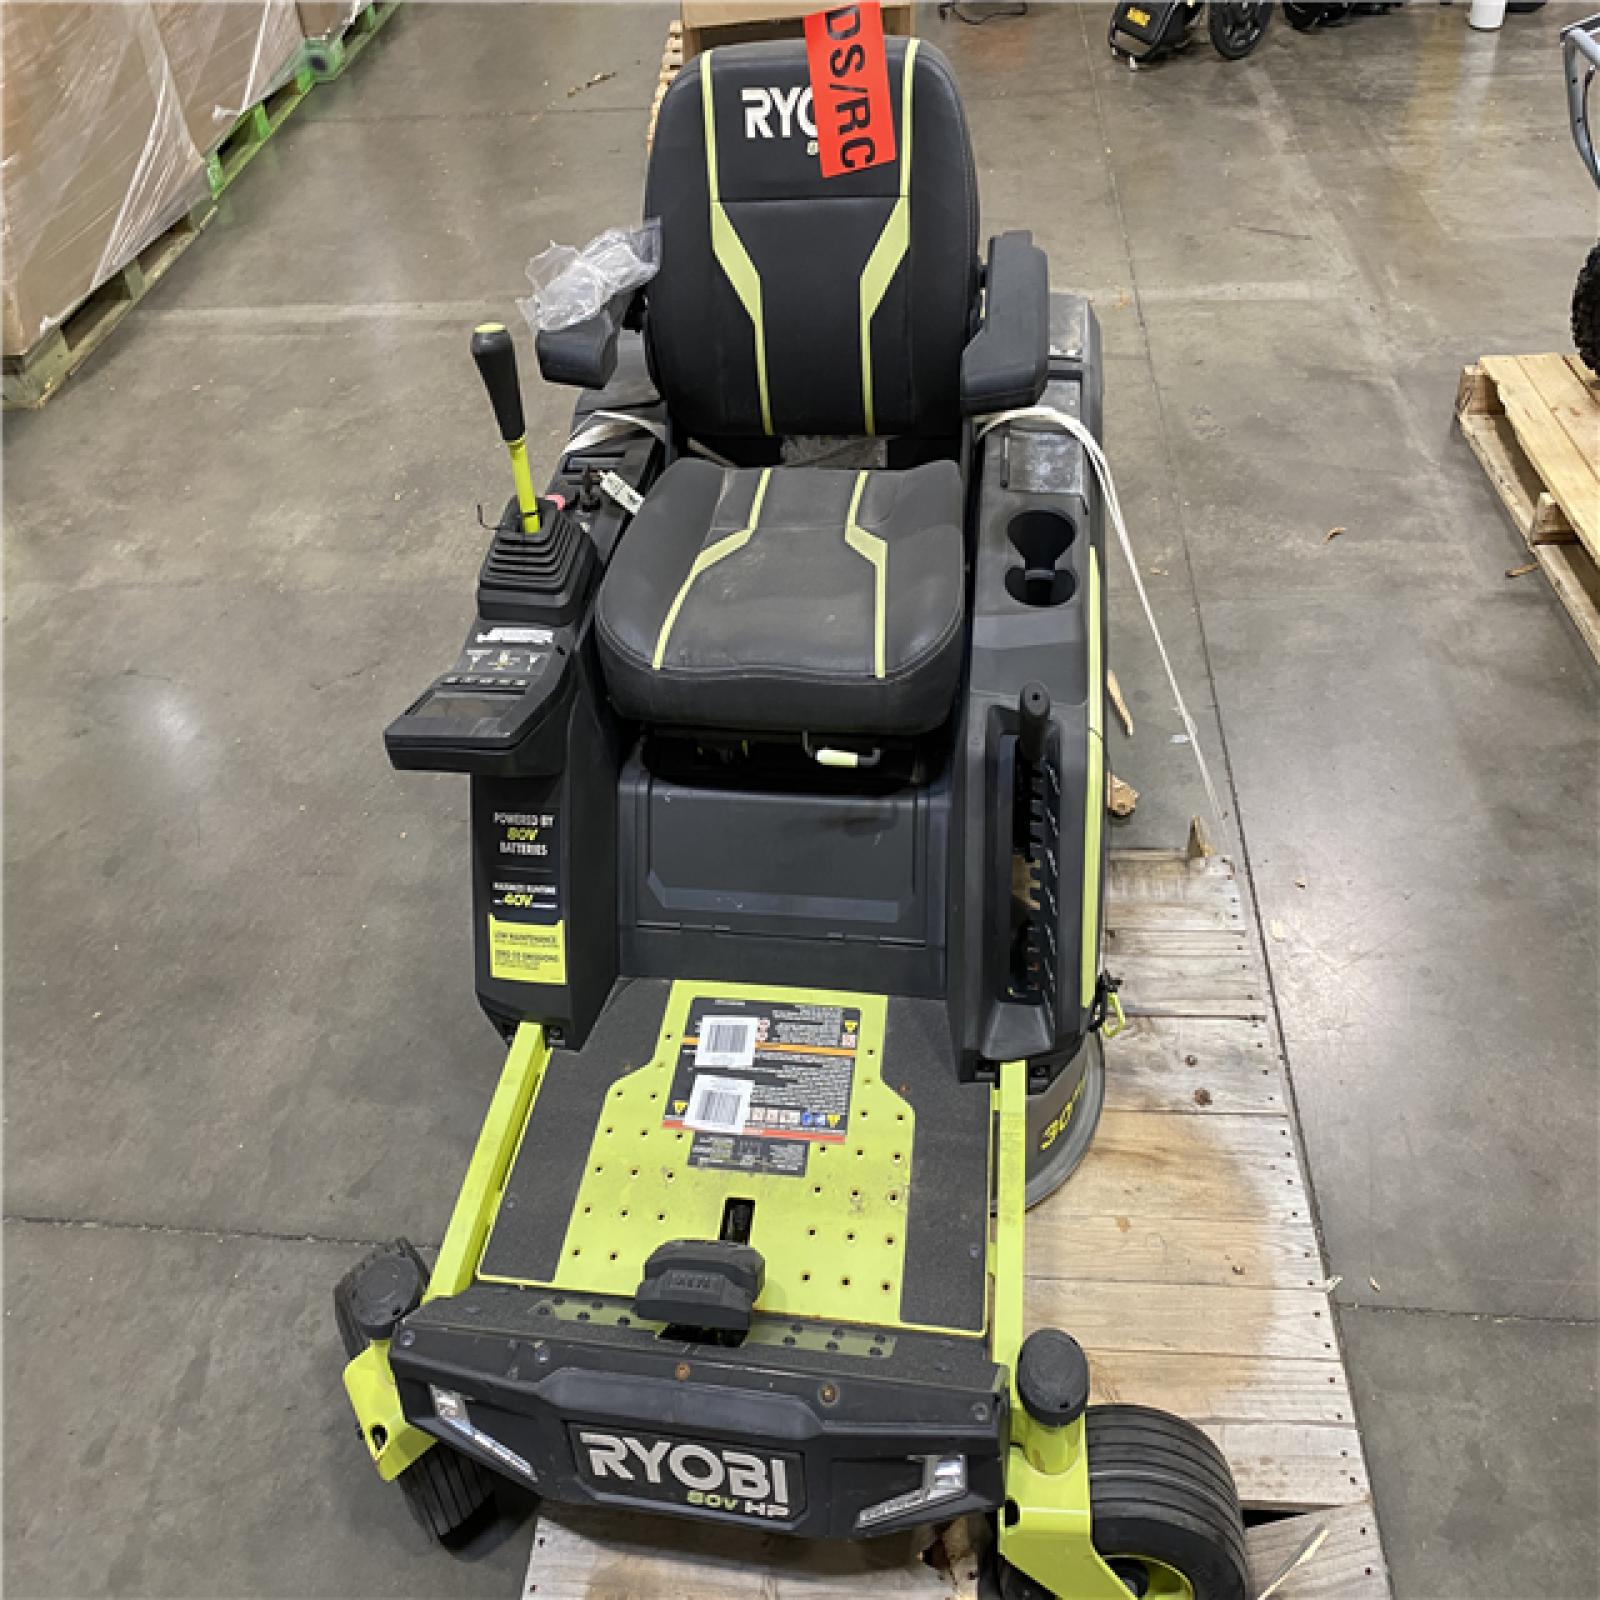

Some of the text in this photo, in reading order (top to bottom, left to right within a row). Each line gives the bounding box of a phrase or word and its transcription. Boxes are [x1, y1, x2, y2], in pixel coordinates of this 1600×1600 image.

[741, 87, 818, 138] RYO
[580, 1432, 789, 1504] RYOBI
[745, 1501, 790, 1517] HP
